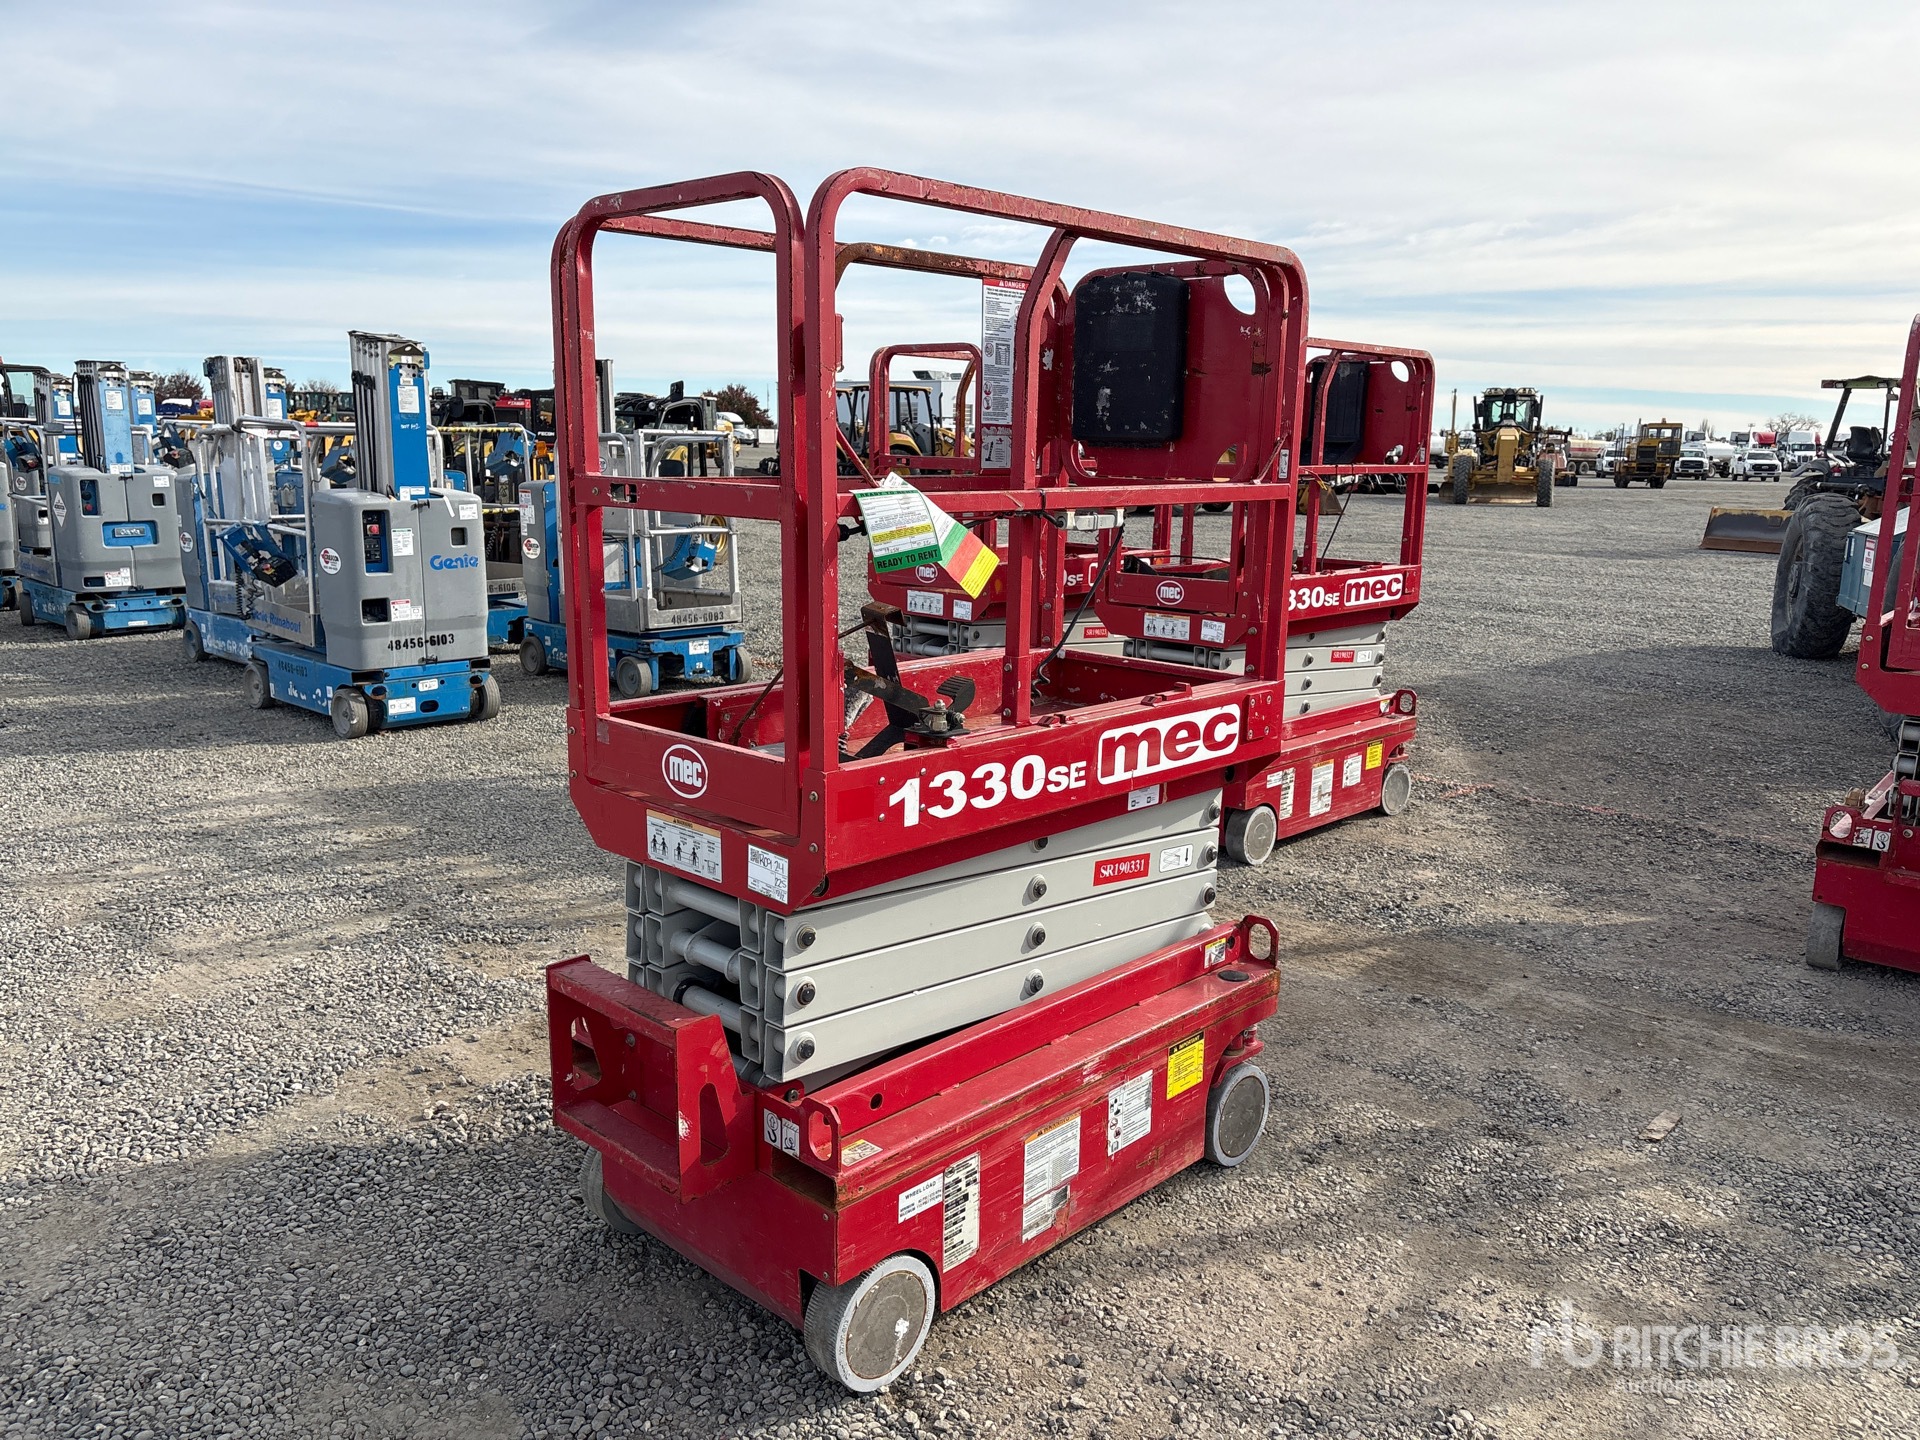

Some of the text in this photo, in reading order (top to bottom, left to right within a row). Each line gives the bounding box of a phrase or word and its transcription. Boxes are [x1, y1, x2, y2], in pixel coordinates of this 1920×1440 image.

[429, 552, 480, 571] Genie
[877, 549, 939, 570] READY TO RENT
[1159, 585, 1181, 600] mec
[1345, 577, 1402, 603] mec
[671, 611, 725, 625] 48456-6083
[387, 633, 455, 651] 48456-6103
[1099, 711, 1239, 779] mec
[669, 755, 703, 788] mec
[1099, 858, 1145, 879] SR190331
[904, 1188, 922, 1201] WHEEL
[922, 1180, 937, 1193] LOAD
